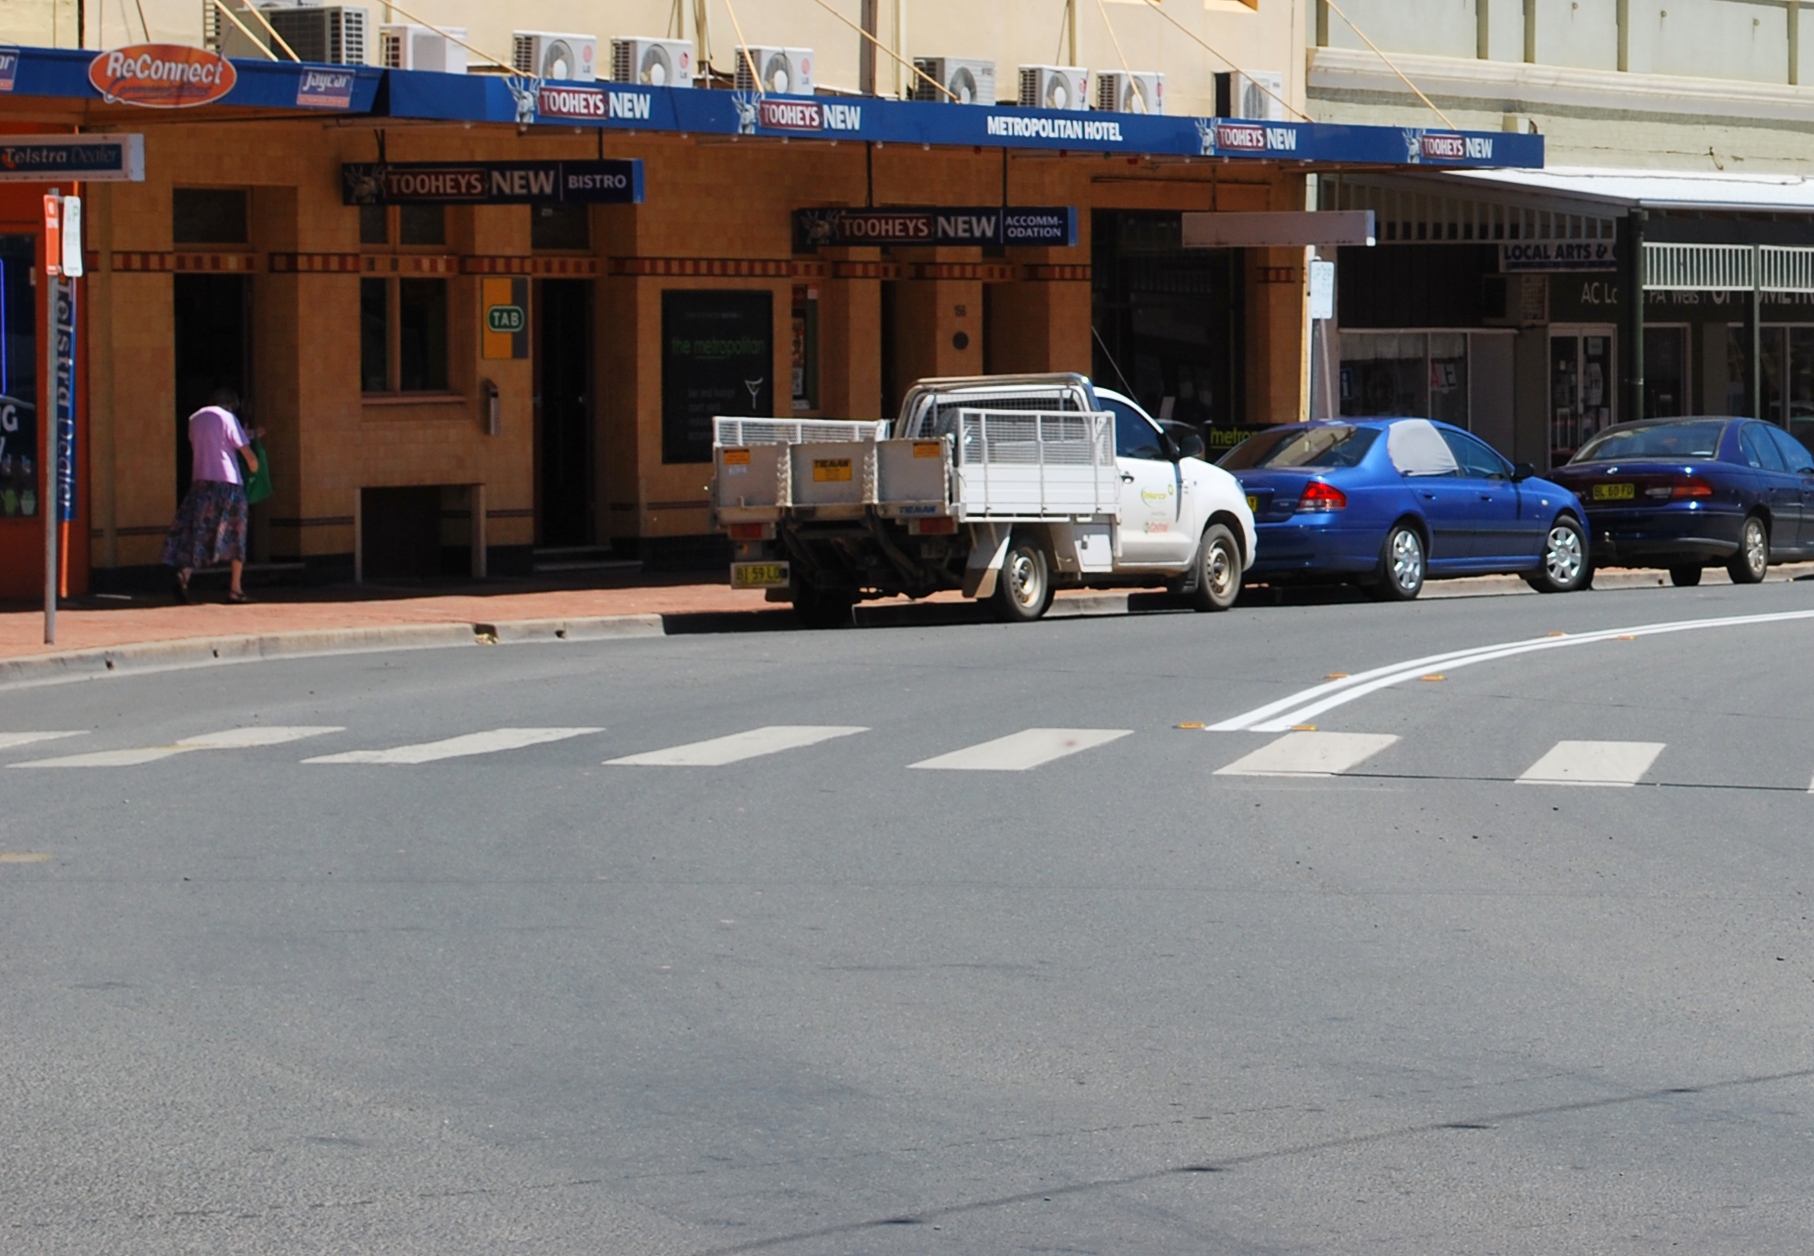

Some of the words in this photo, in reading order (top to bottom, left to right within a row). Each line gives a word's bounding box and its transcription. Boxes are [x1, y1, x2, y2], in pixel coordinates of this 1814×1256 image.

[105, 51, 224, 85] ReConnect
[541, 90, 605, 115] TOOHEYS
[609, 91, 651, 120] NEW
[764, 102, 819, 127] TOOHEYS
[823, 104, 861, 130] NEW
[987, 115, 1082, 140] METROPOLITAN
[1084, 120, 1123, 142] HOTEL
[1219, 125, 1264, 147] TOOHEYS
[1266, 127, 1297, 151] NEW
[4, 146, 68, 164] Telstra
[71, 145, 118, 164] Dealer
[1424, 137, 1463, 156] TOOHEYS
[1466, 137, 1493, 159] NEW
[388, 173, 483, 194] TOOHEYS
[491, 169, 555, 195] NEW
[567, 174, 627, 189] BISTRO
[841, 218, 929, 237] TOOHEYS
[936, 216, 996, 238] NEW
[1005, 215, 1063, 227] ACCOMM-
[1007, 226, 1062, 238] ODATION
[1504, 245, 1551, 261] LOCAL
[1555, 244, 1592, 260] ARTS
[1596, 244, 1608, 259] &
[1580, 282, 1600, 304] AC
[491, 310, 520, 328] TAB
[57, 279, 73, 407] Telstra
[1210, 427, 1258, 444] metro
